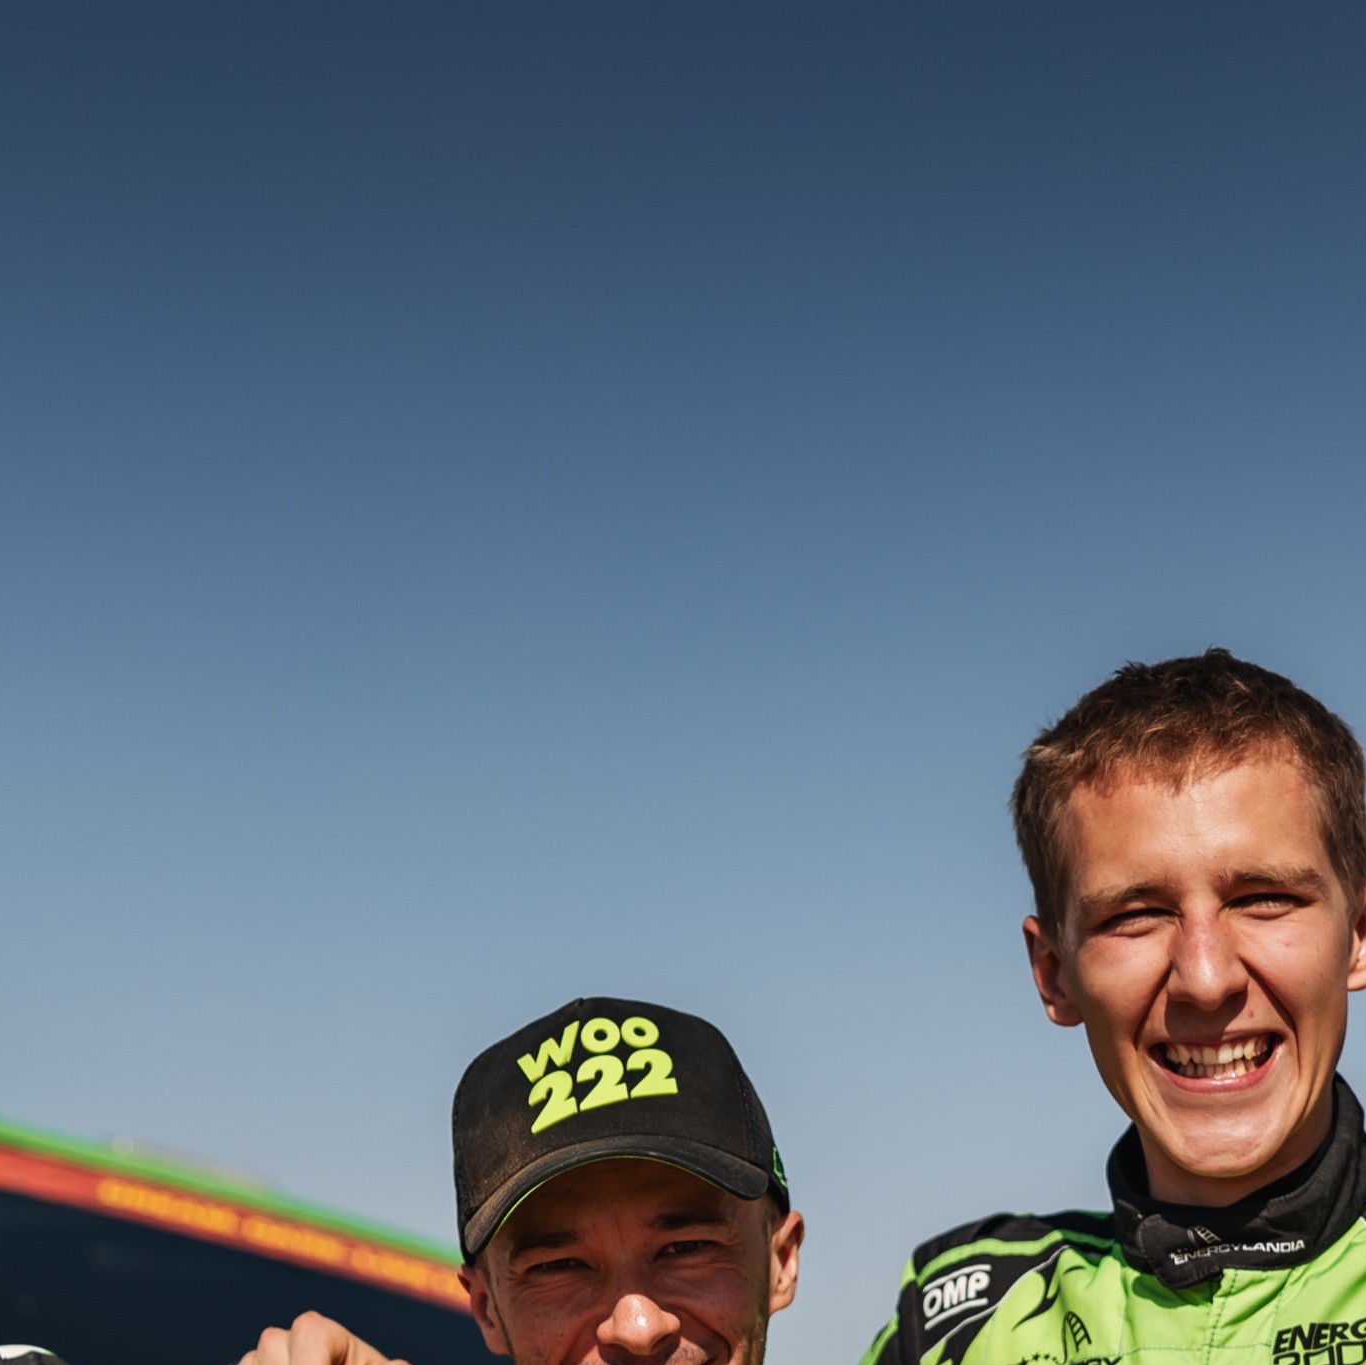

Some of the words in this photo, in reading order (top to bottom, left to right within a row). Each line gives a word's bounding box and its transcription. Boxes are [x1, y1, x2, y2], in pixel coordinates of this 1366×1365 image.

[517, 1016, 660, 1083] WOO
[528, 1048, 679, 1135] 222
[1174, 1238, 1306, 1266] ENERGYLANDIA
[923, 1271, 991, 1319] OMP
